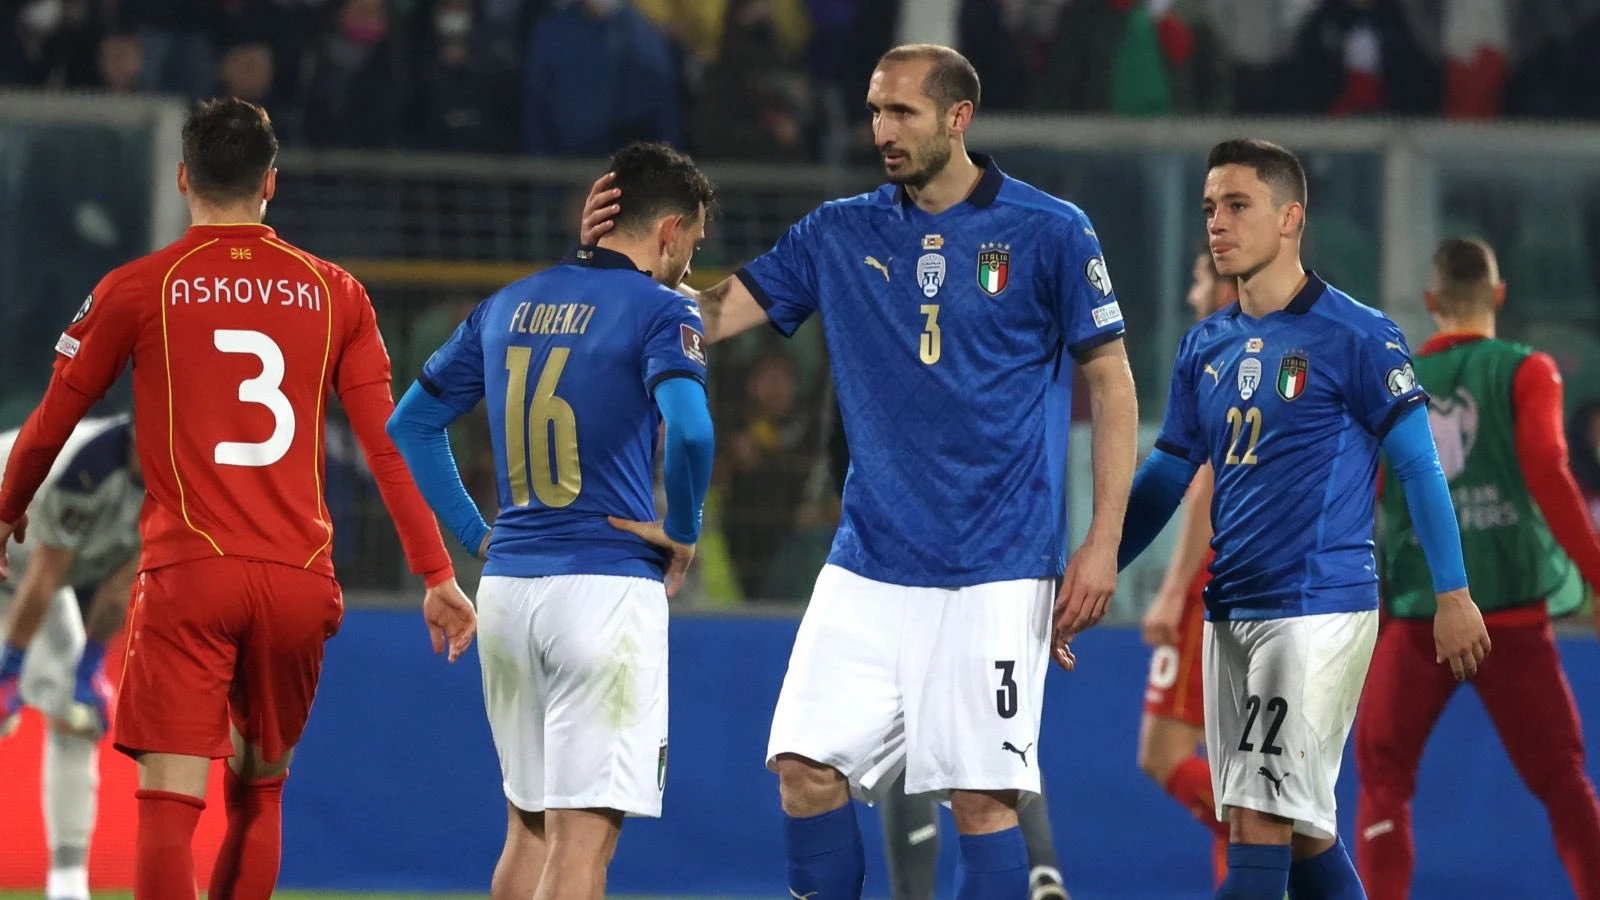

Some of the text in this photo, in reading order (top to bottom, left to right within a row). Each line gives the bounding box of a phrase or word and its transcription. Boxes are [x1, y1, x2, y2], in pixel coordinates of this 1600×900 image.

[981, 253, 1008, 261] ITALIA
[171, 277, 320, 311] ASKOVSKI
[508, 302, 596, 335] FLORENZI
[919, 304, 941, 366] 3
[213, 329, 296, 466] 3
[505, 346, 582, 508] 16
[1225, 407, 1263, 465] 22
[995, 660, 1018, 719] 3
[1238, 695, 1289, 756] 22
